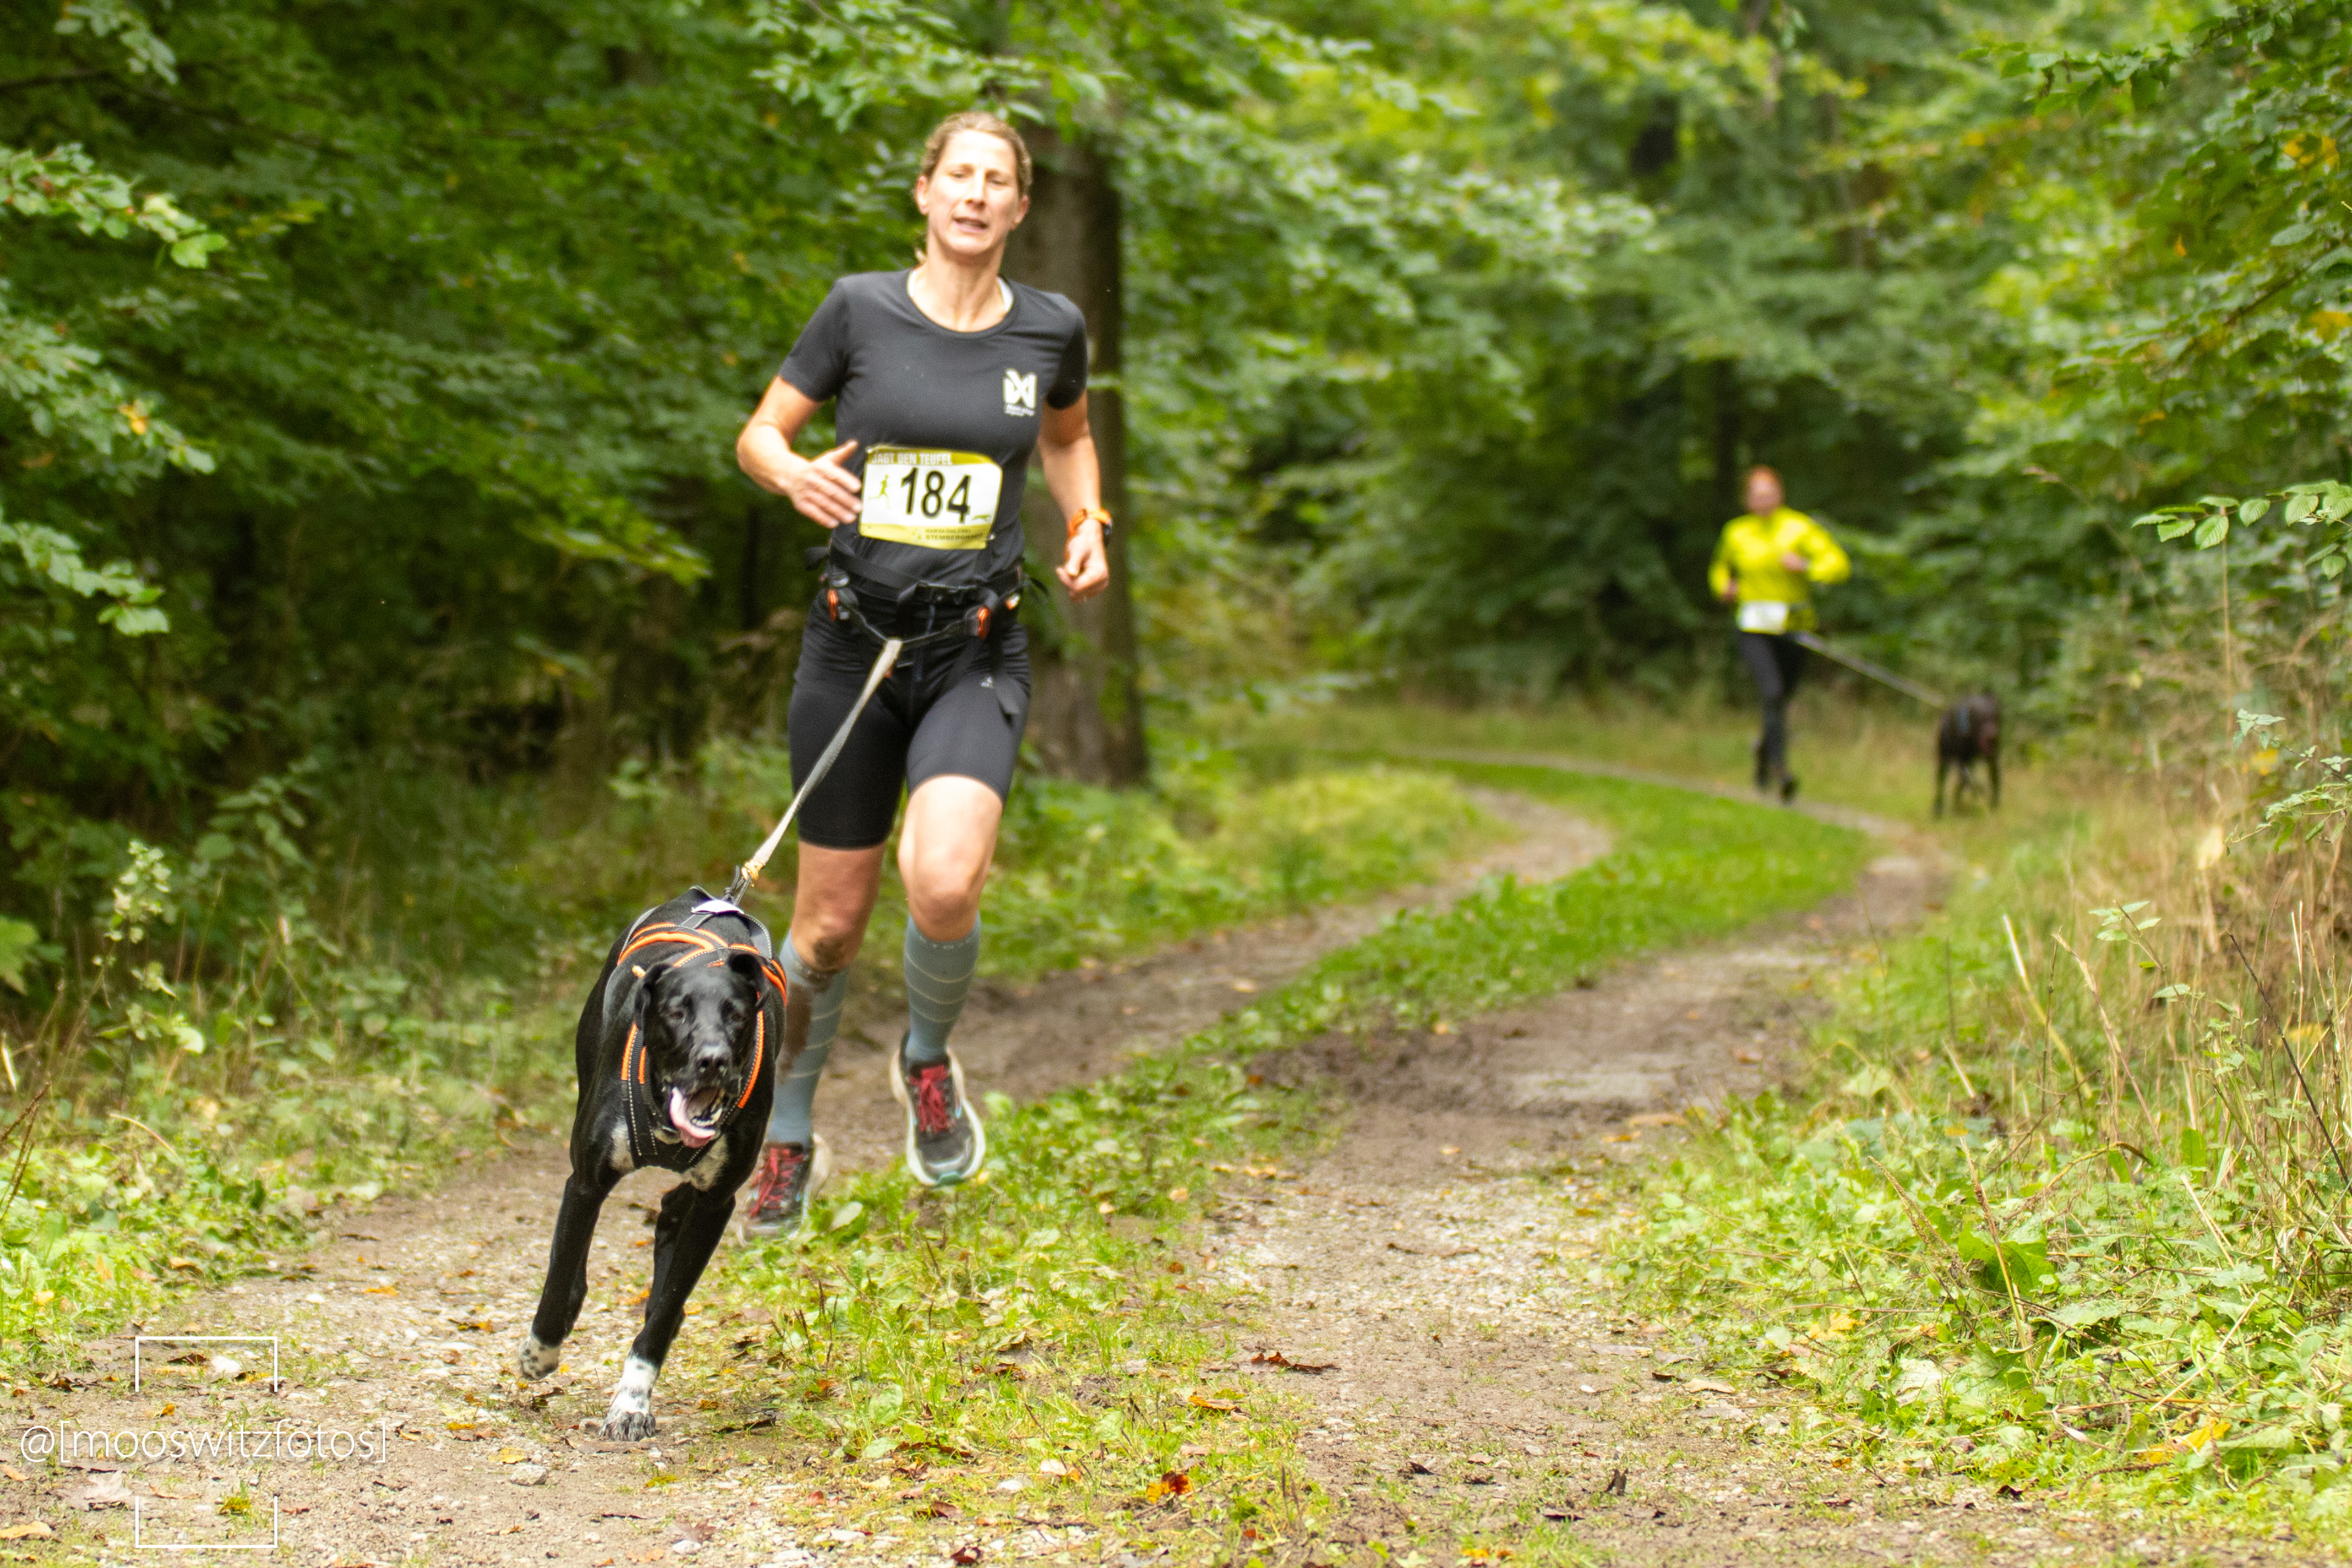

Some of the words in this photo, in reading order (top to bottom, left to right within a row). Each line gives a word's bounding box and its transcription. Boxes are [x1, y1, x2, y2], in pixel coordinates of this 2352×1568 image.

[871, 452, 894, 464] JAGT
[897, 452, 917, 464] DEN
[919, 452, 952, 465] TEUFEL
[901, 467, 971, 523] 184
